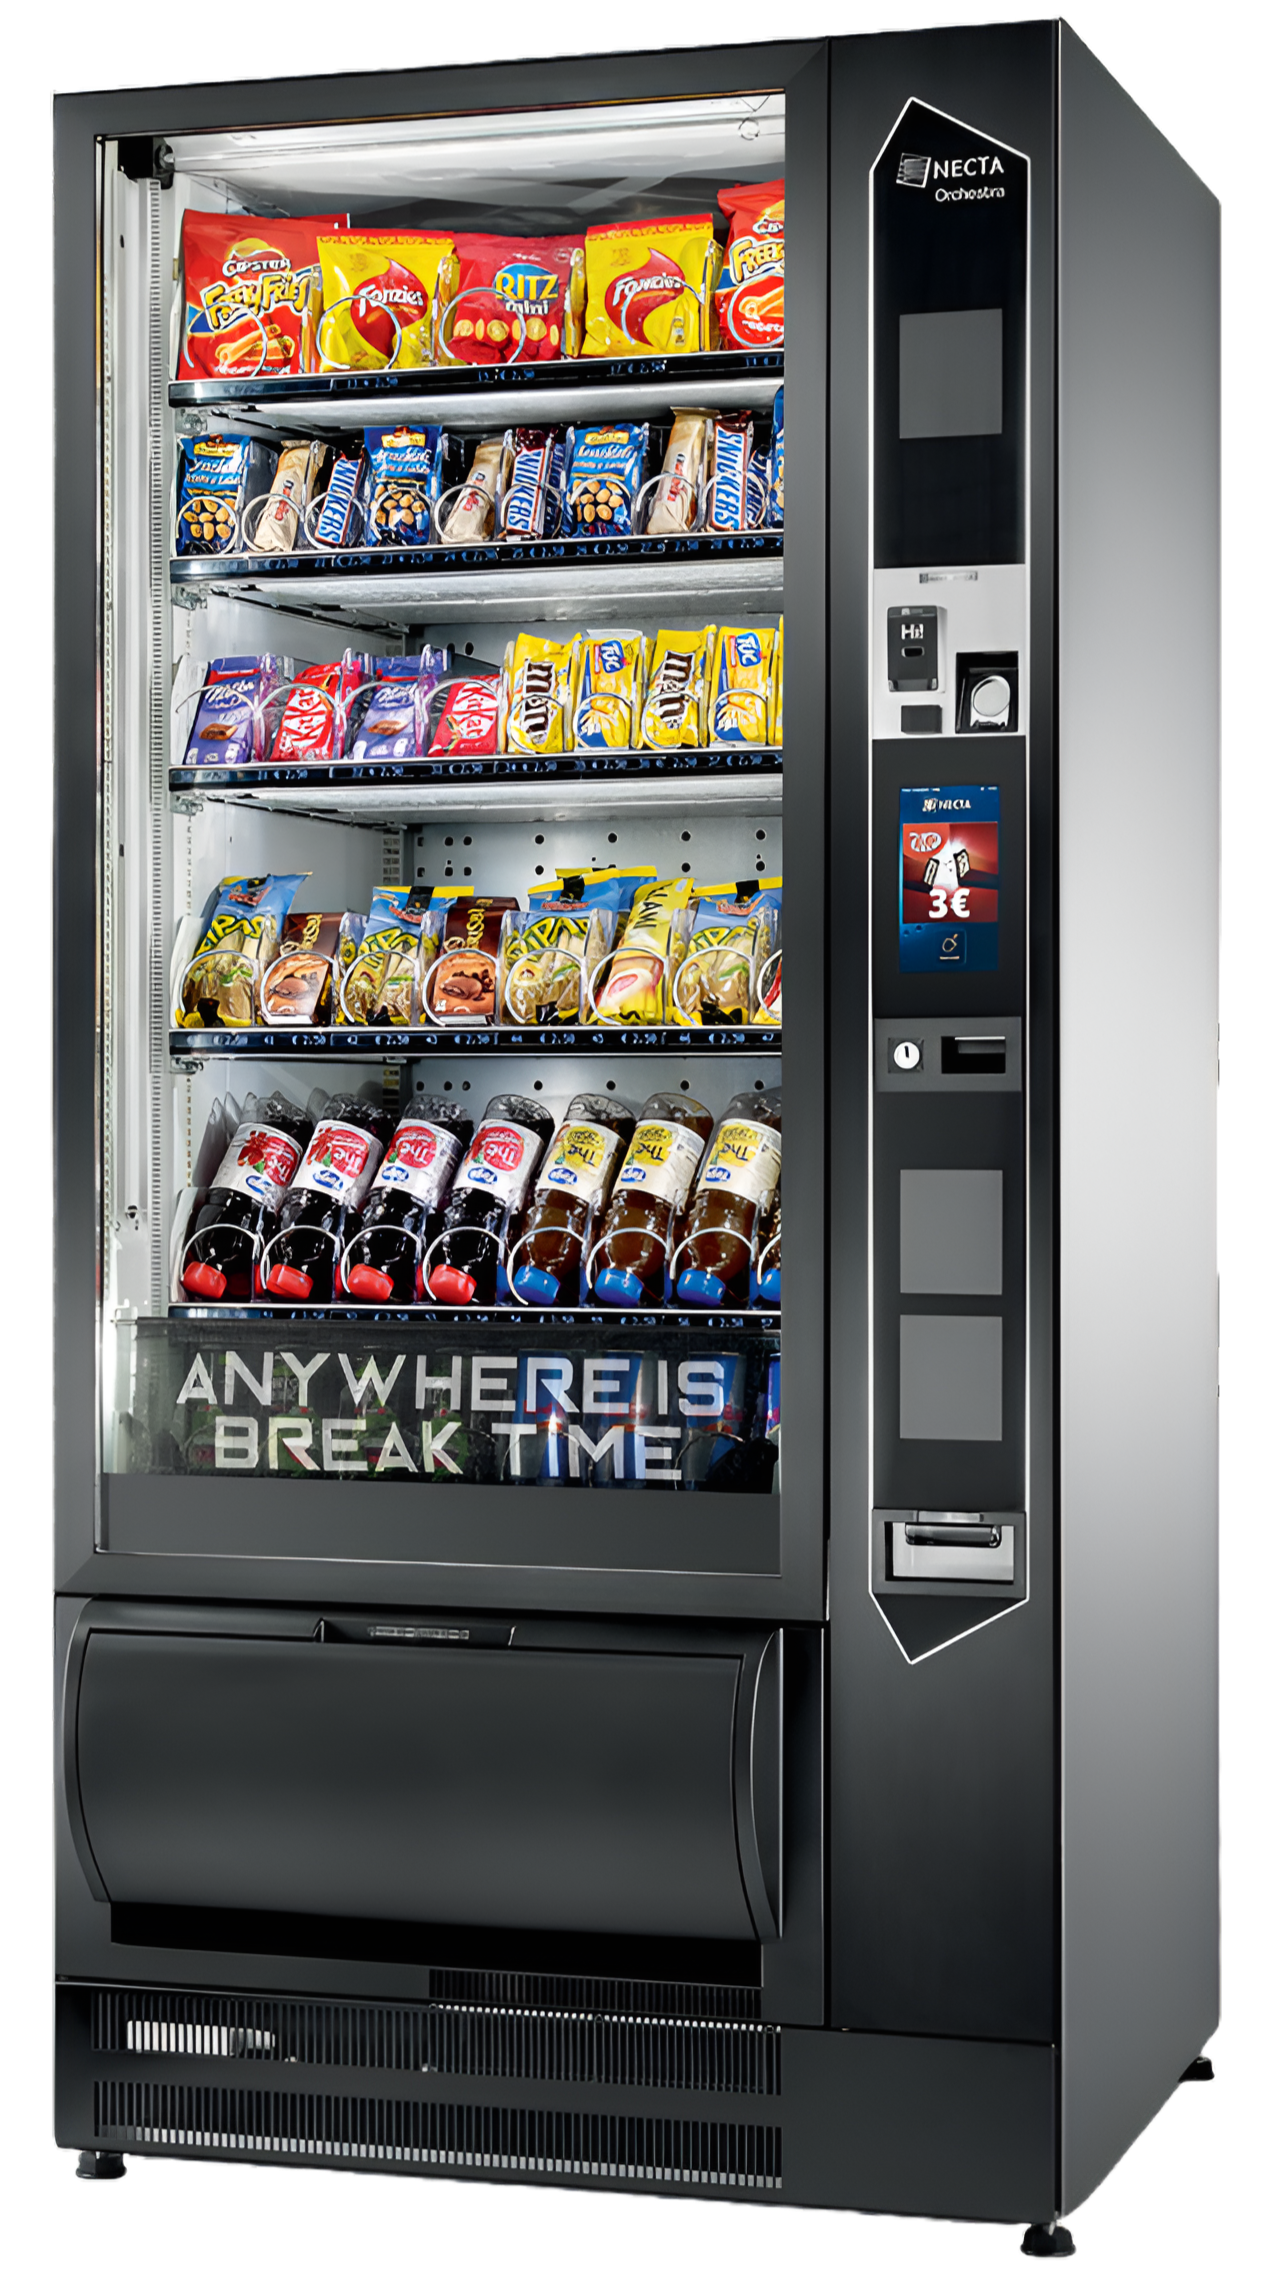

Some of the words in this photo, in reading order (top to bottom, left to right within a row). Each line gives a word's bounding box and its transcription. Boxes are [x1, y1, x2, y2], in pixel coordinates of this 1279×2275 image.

[933, 157, 1004, 179] NECTA
[935, 187, 1005, 202] Orchestra
[358, 284, 424, 317] Fonzies
[495, 271, 558, 300] RITZ
[505, 300, 549, 316] mini
[715, 429, 742, 530] SNICKERS
[928, 888, 971, 919] 3€
[177, 1351, 630, 1414] ANYWHERE
[659, 1360, 724, 1417] IS
[214, 1416, 464, 1475] BREAK
[491, 1422, 683, 1481] TIME
